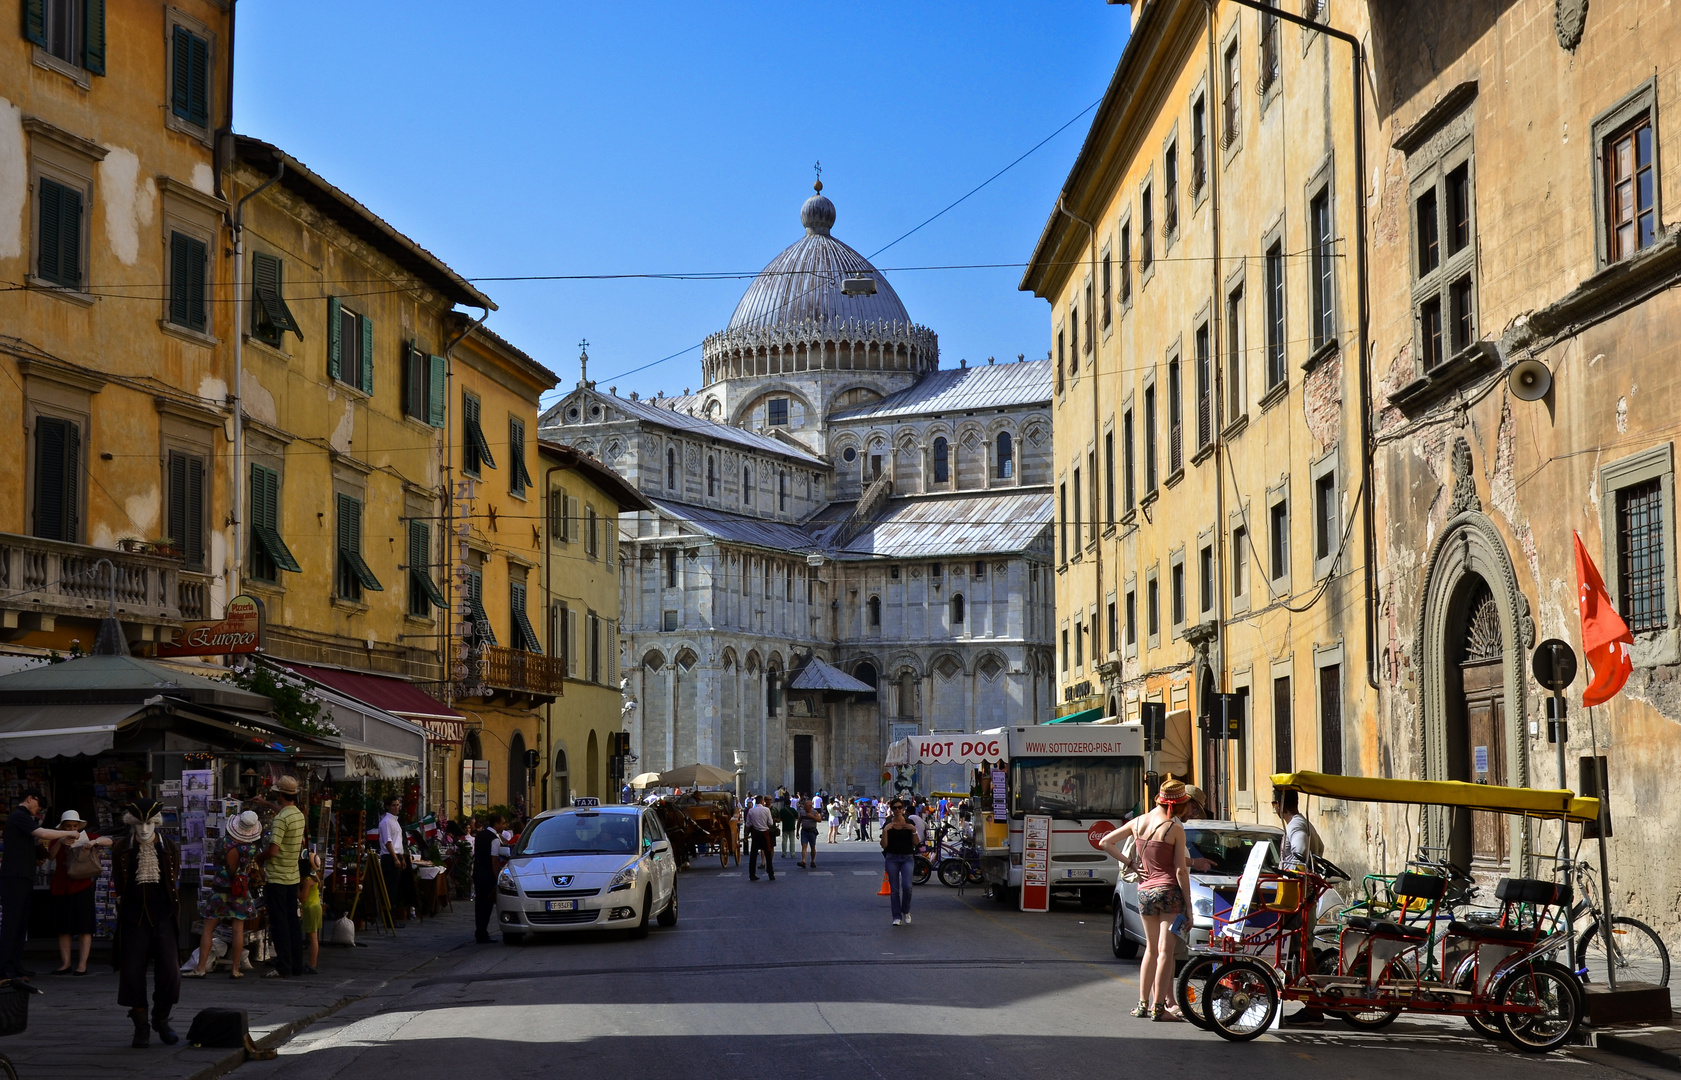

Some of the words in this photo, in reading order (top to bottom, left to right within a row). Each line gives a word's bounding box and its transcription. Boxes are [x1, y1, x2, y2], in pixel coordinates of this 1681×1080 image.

[232, 603, 254, 612] Pizzeria
[920, 742, 953, 757] HOT
[961, 741, 999, 757] DOG
